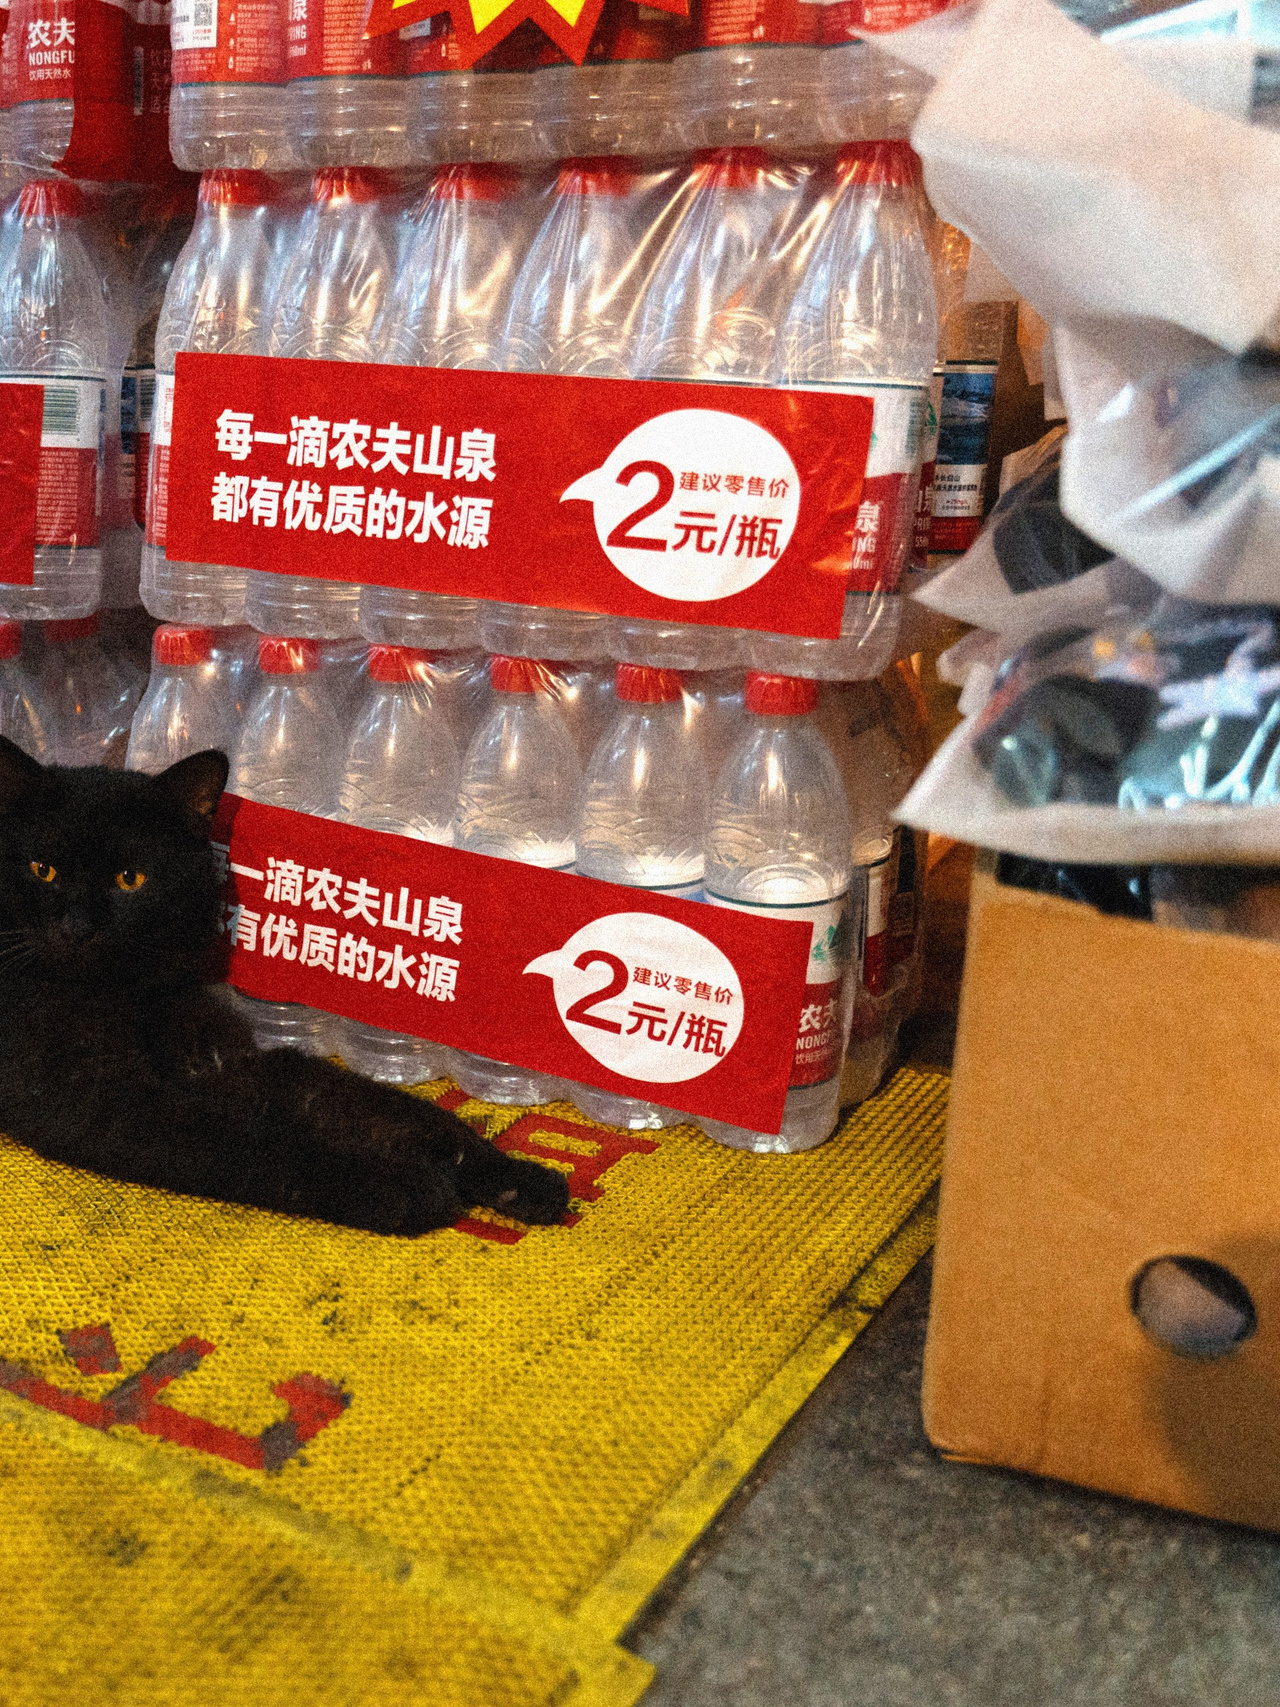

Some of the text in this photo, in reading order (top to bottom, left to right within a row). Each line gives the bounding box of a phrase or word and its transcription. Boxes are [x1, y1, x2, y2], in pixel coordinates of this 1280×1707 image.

[27, 18, 75, 48] 农夫
[28, 50, 75, 66] NONGFU
[215, 409, 497, 482] 每一滴农夫山泉
[210, 471, 493, 549] 都有优质的水源
[606, 460, 782, 560] 2元/瓶
[679, 471, 790, 499] 建议零售价
[218, 903, 461, 1003] 有优质的水源
[632, 966, 733, 1005] 建议零售价
[566, 949, 726, 1058] 2元/瓶
